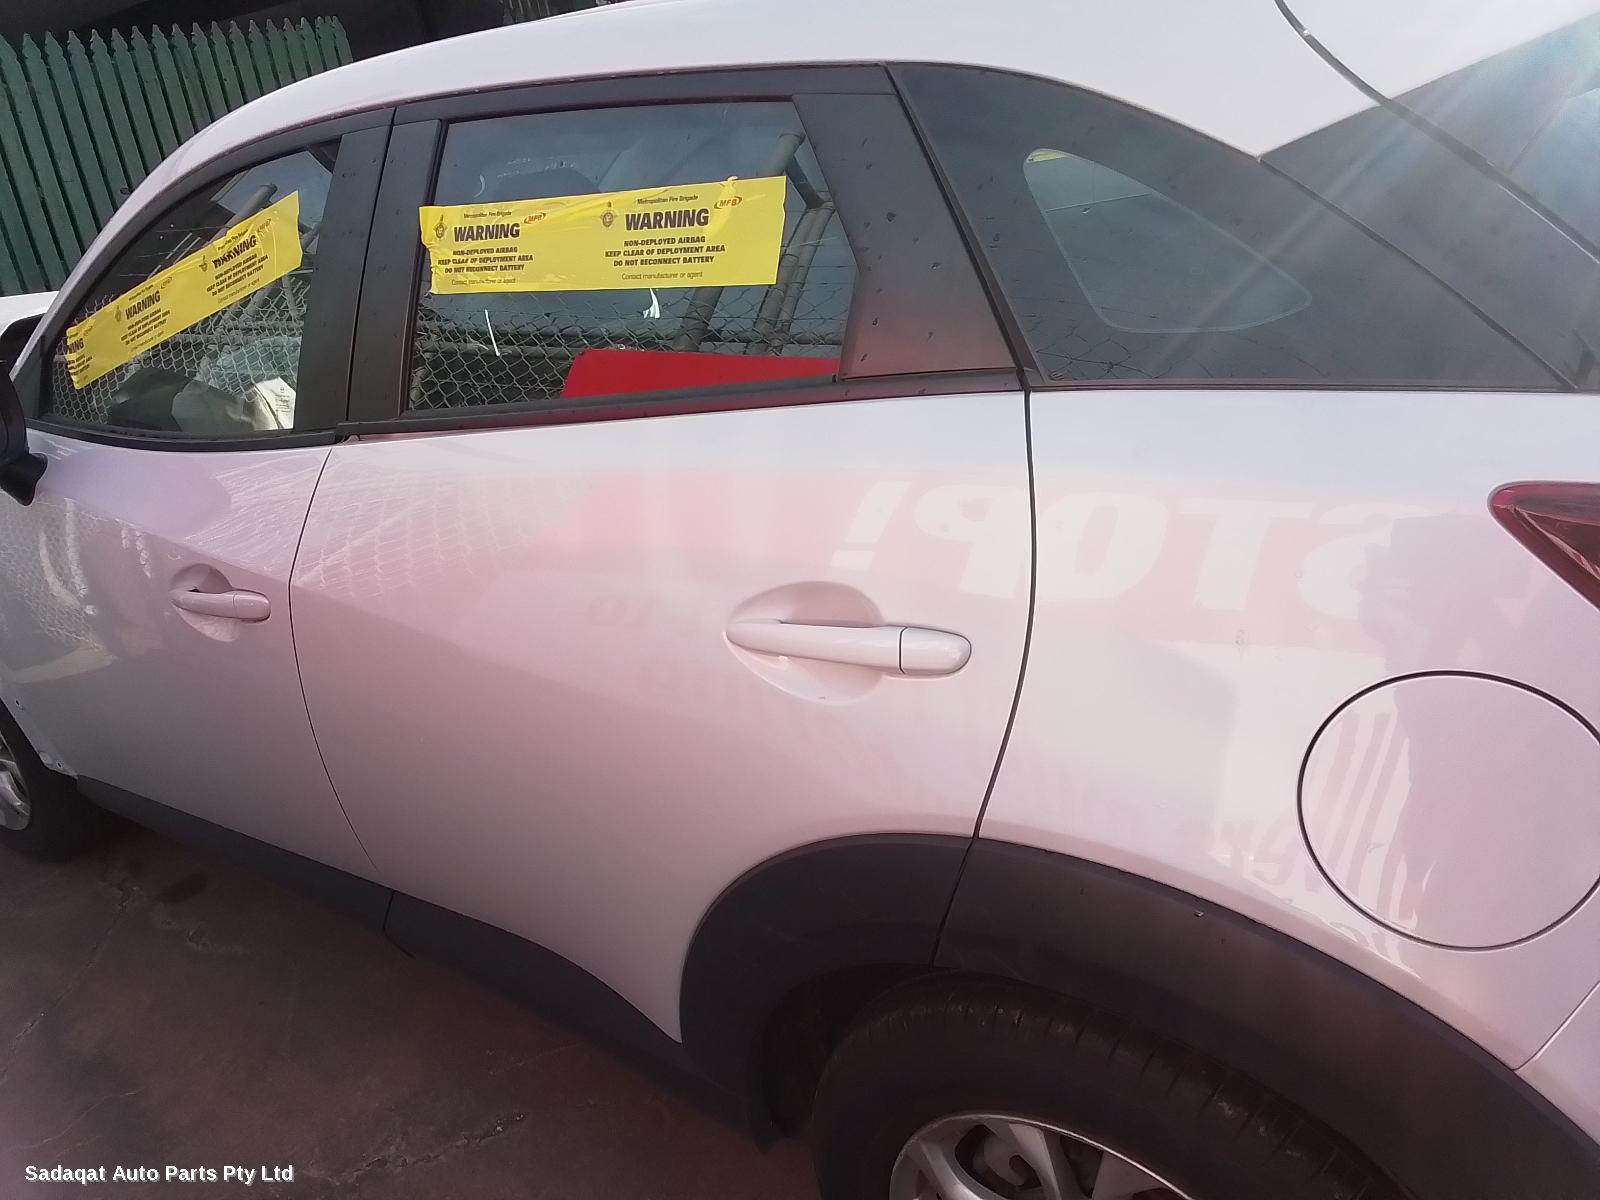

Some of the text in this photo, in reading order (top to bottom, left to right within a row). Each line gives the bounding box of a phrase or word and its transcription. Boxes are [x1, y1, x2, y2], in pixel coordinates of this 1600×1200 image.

[625, 208, 709, 231] WARNING
[453, 222, 520, 242] WARNING
[624, 235, 706, 247] NON-DEPLOYED AIRBAG
[496, 246, 518, 254] AIRBAG
[605, 250, 621, 258] KEEP
[656, 246, 704, 255] DEPLOYMENT
[706, 244, 725, 253] AREA
[479, 255, 517, 263] DEPLOYMENT
[640, 257, 680, 266] RECONNECT
[682, 255, 714, 264] BATTERY
[621, 272, 642, 280] Contact
[125, 289, 161, 321] WARNING
